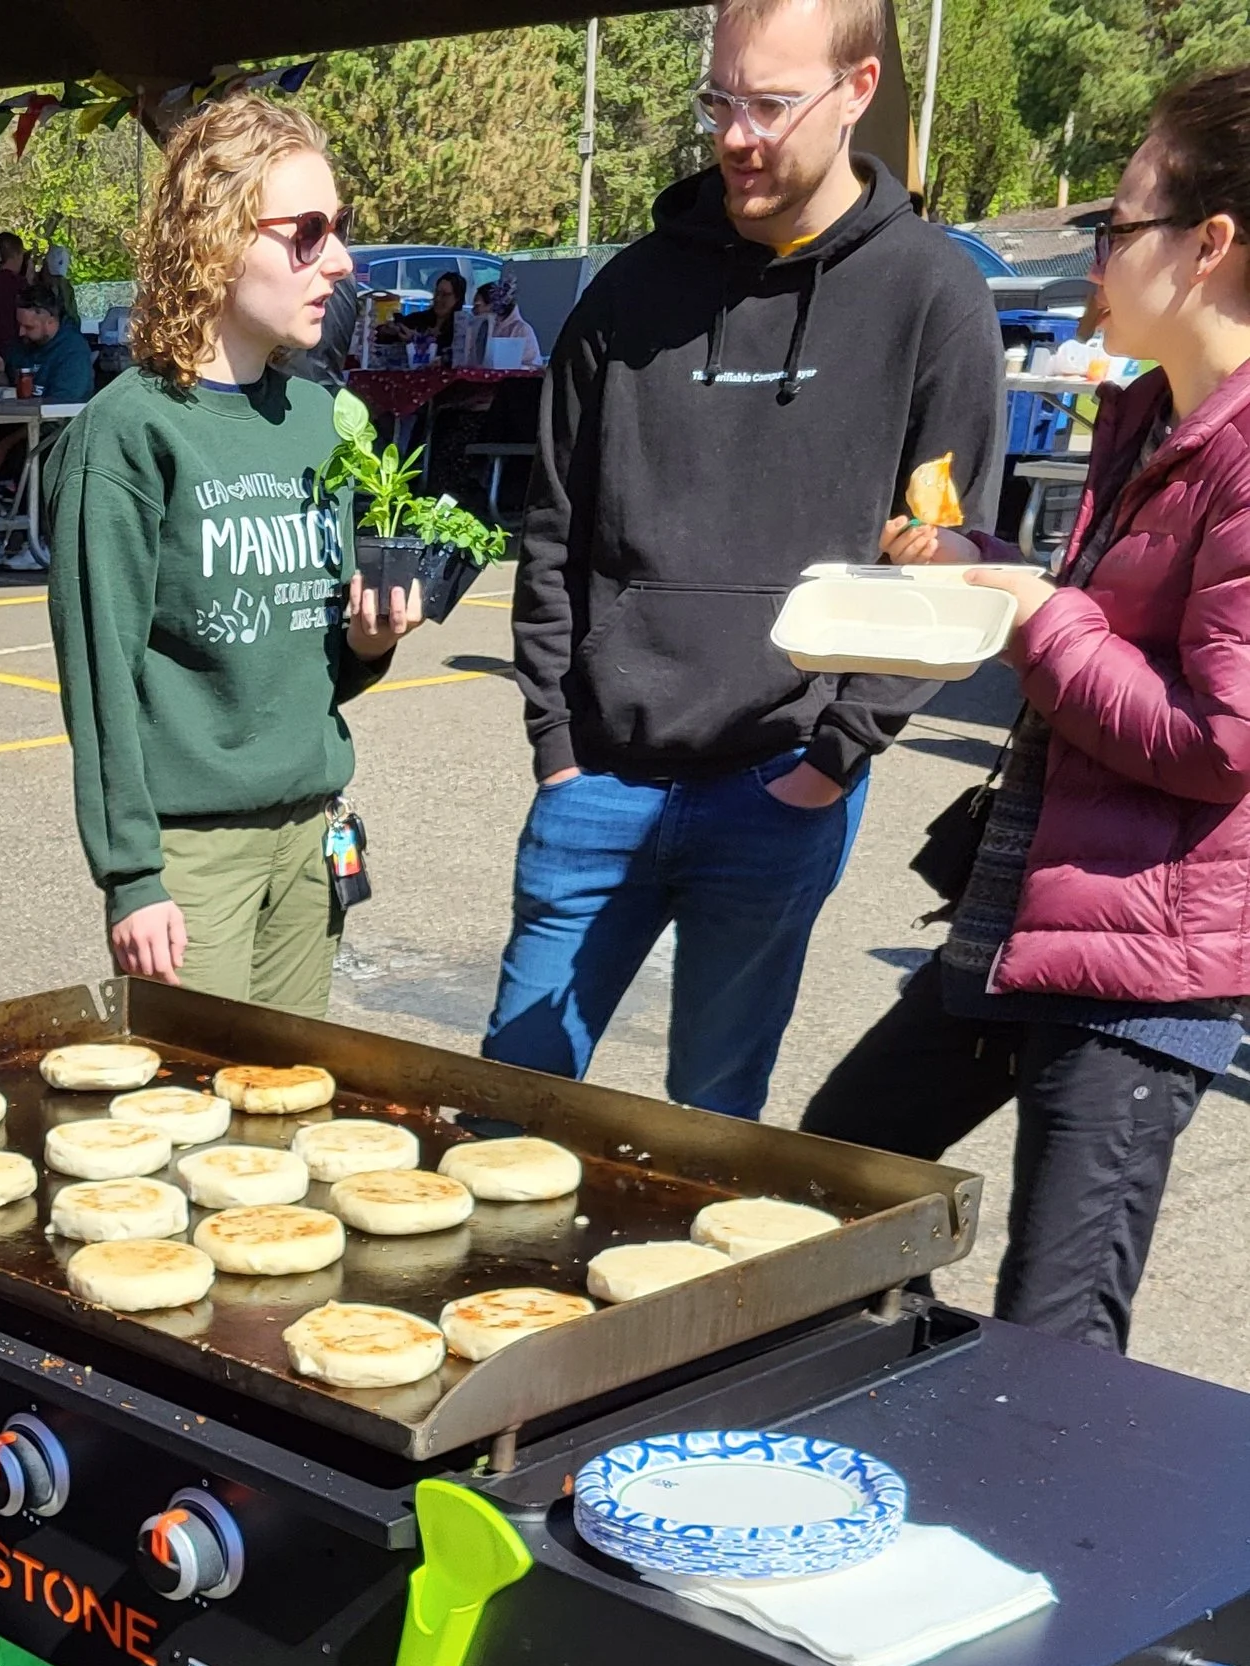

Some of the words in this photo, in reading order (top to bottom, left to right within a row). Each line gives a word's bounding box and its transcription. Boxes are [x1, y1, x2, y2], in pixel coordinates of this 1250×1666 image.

[714, 370, 751, 382] erifiable
[195, 479, 229, 510] LEAD
[239, 473, 281, 498] WITH
[202, 508, 342, 577] MANITOU
